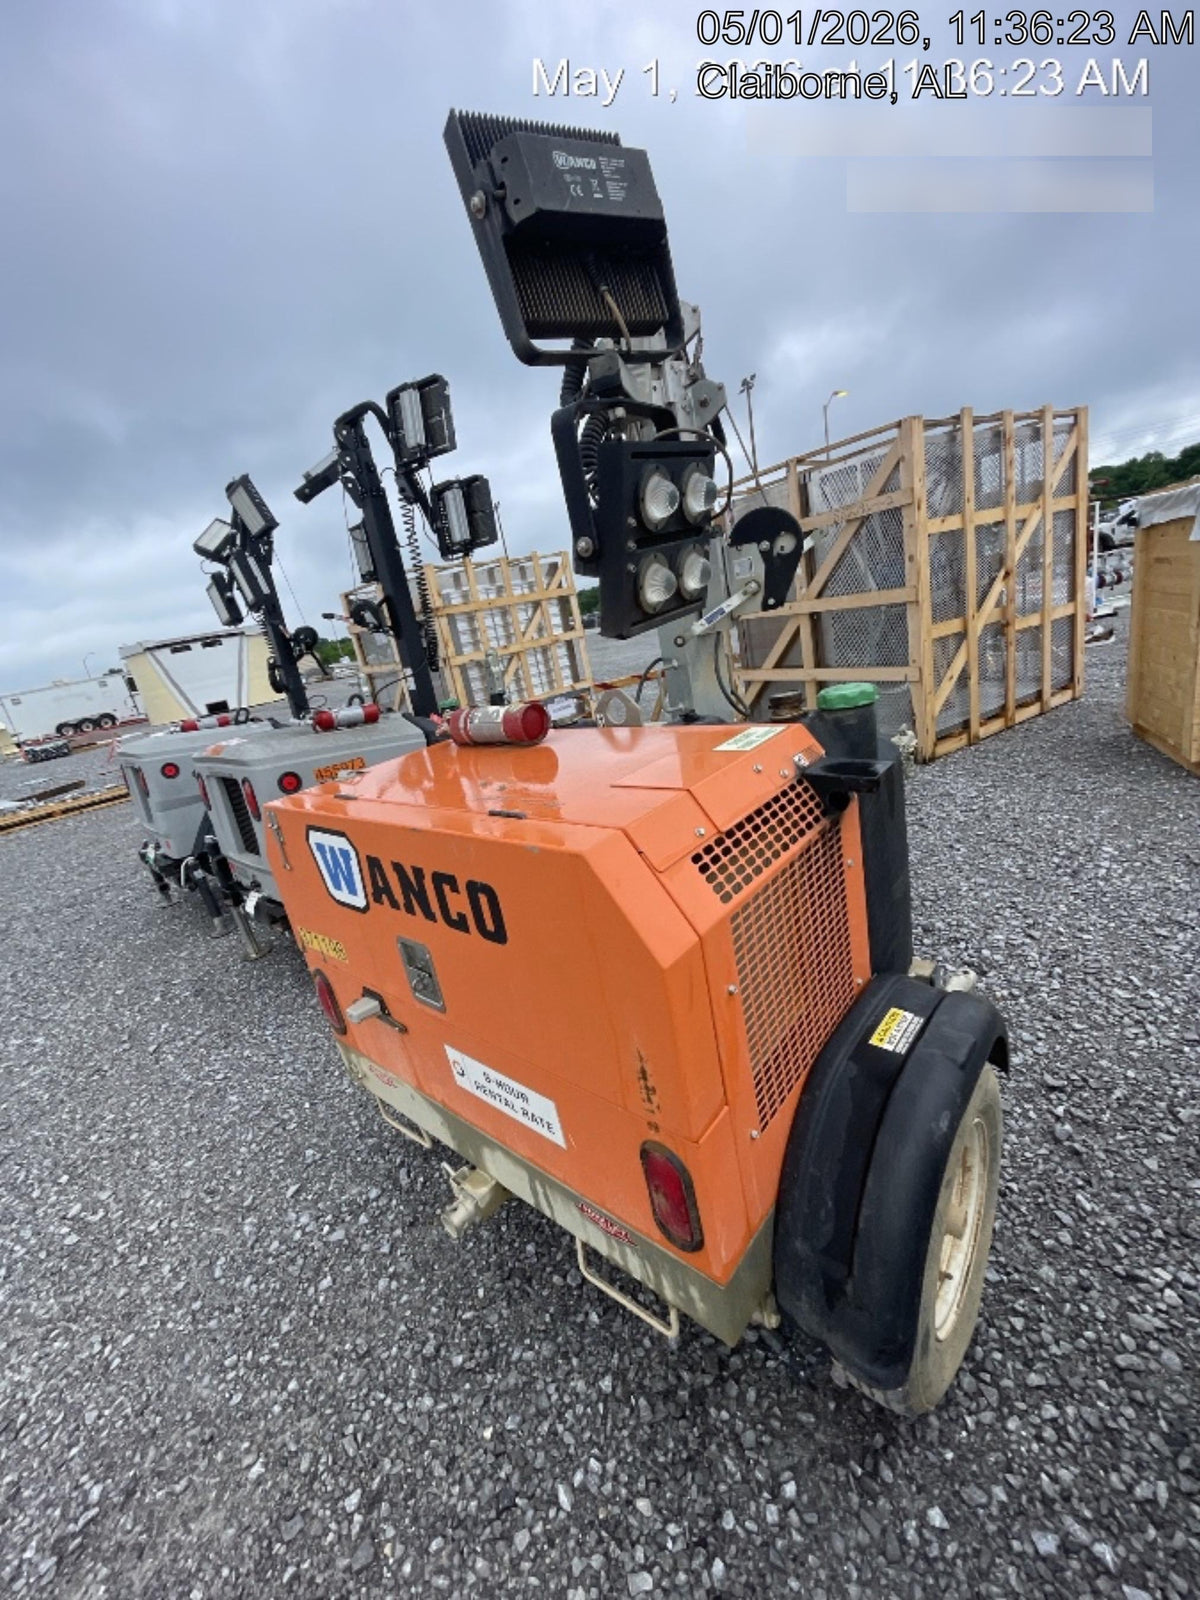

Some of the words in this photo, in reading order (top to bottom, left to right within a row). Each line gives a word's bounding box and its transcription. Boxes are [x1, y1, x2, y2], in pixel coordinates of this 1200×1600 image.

[306, 825, 507, 945] WANCO
[474, 1080, 518, 1113] RENTAL
[520, 1106, 556, 1135] RATE
